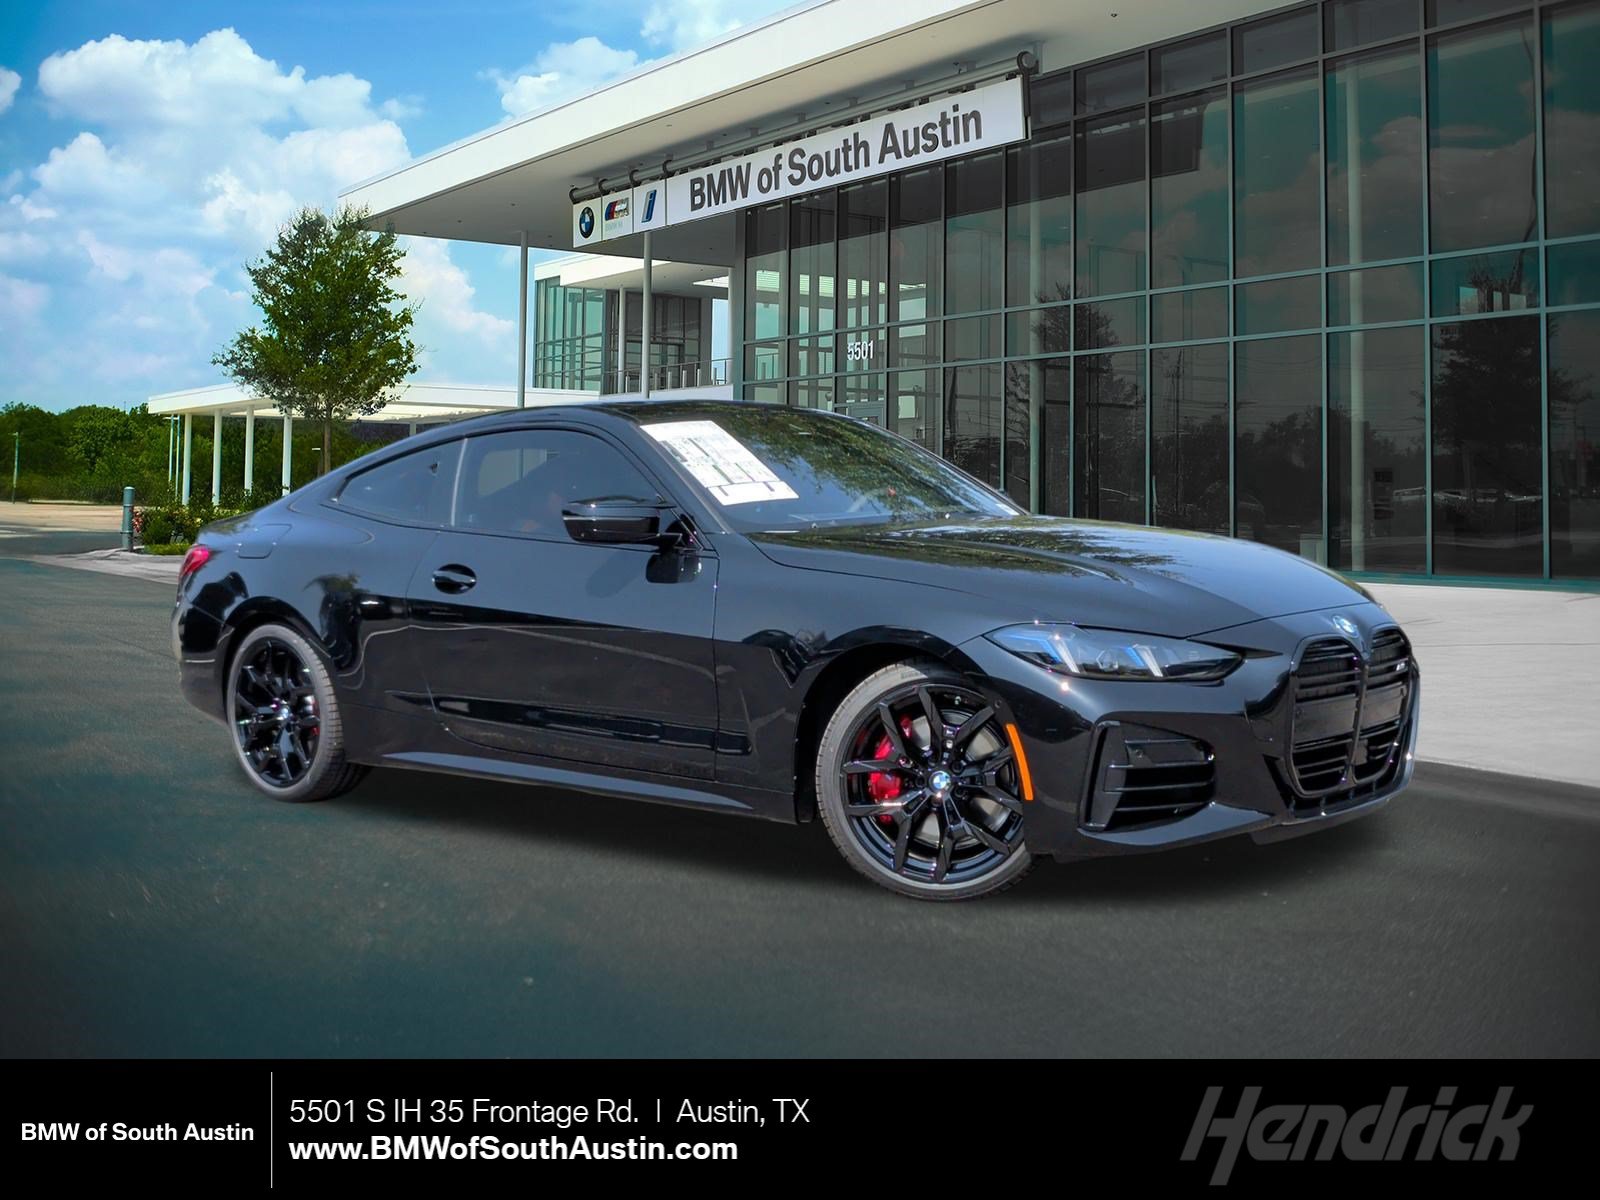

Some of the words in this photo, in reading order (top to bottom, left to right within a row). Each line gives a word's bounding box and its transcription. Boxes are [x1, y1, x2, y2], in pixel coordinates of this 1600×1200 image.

[690, 162, 752, 212] BMW
[757, 153, 782, 195] of
[787, 132, 871, 186] South
[878, 104, 982, 164] Austin
[847, 340, 874, 360] 5501
